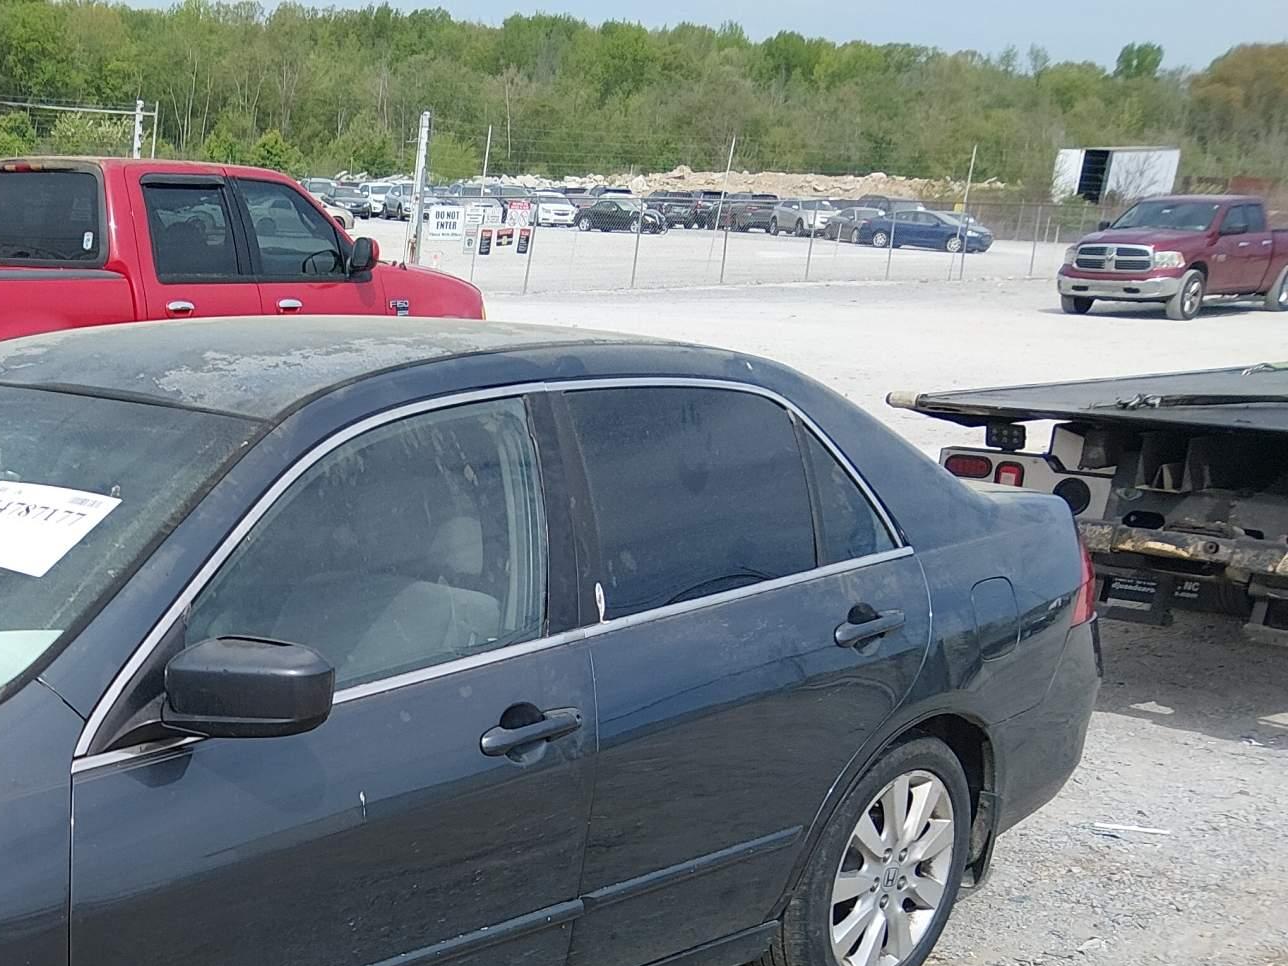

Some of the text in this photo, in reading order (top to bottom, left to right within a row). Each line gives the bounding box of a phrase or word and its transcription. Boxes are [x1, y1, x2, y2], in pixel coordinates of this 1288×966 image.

[435, 210, 446, 220] DO
[446, 210, 460, 220] NOT
[436, 221, 457, 230] ENTER
